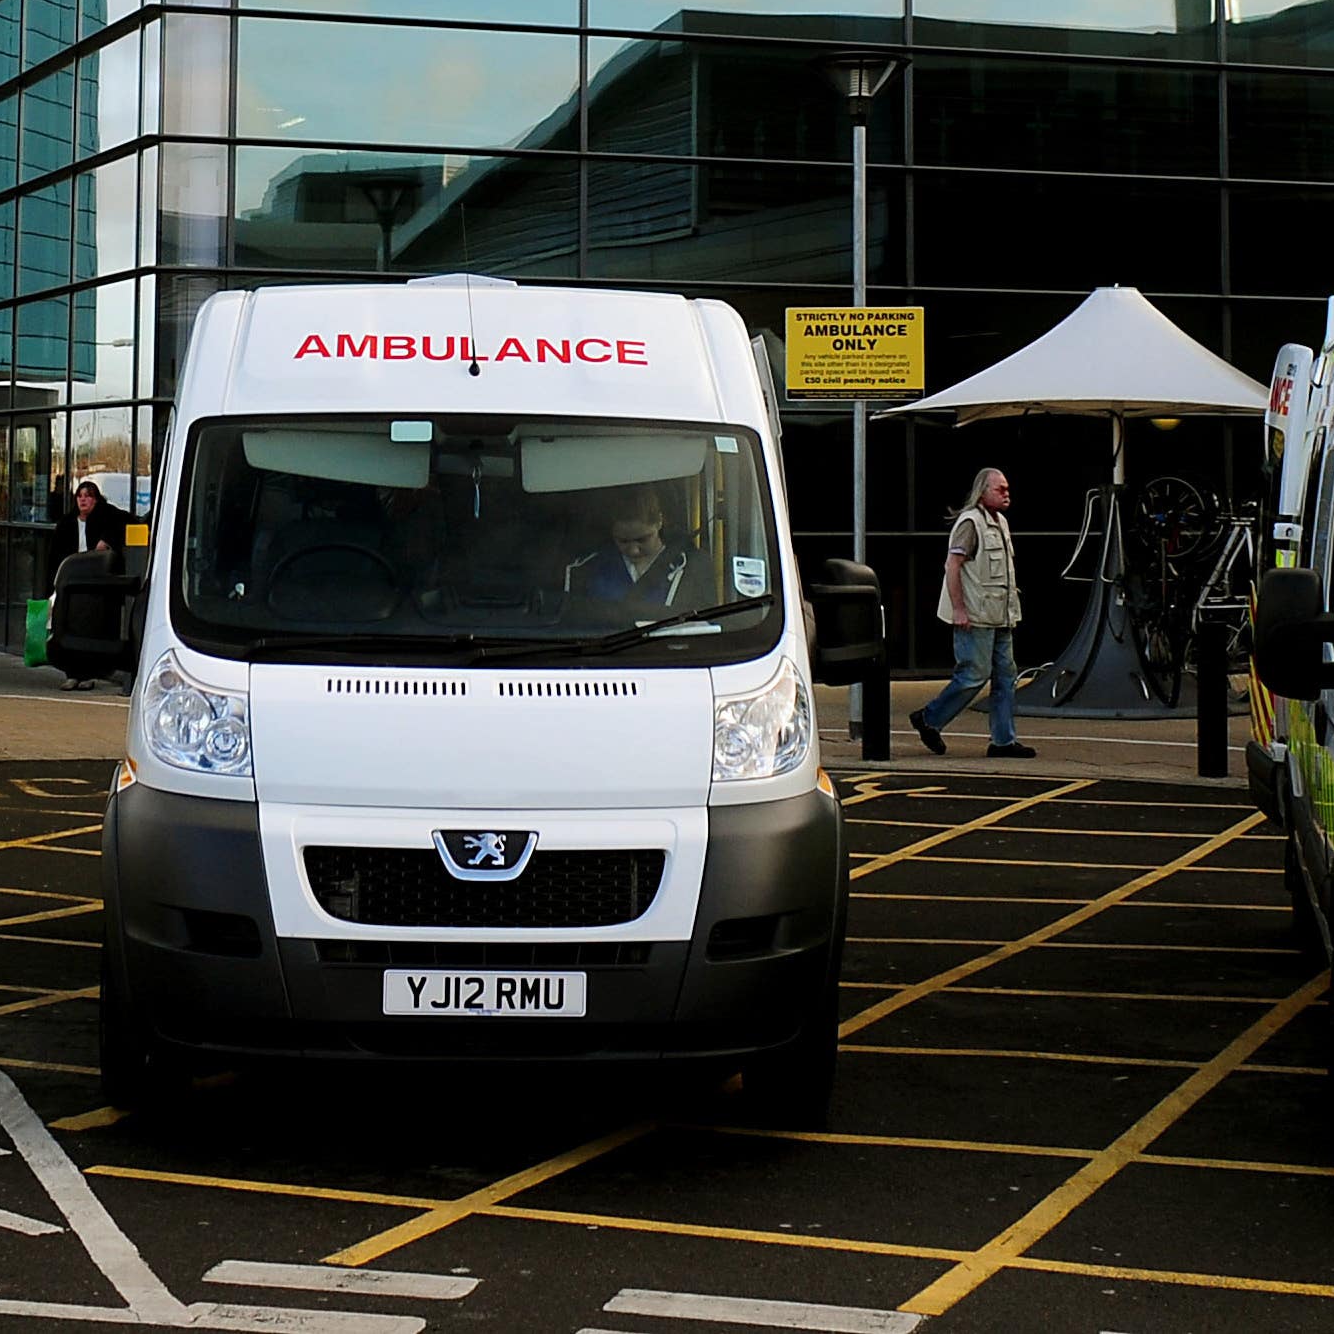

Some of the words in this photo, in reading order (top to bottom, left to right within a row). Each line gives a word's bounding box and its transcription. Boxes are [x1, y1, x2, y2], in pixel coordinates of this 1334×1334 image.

[796, 313, 845, 321] STRICTLY
[804, 324, 907, 336] AMBULANCE
[294, 334, 649, 366] AMBULANCE
[832, 339, 878, 351] ONLY
[844, 377, 876, 385] penalty
[407, 977, 485, 1009] YJ12
[496, 978, 564, 1009] RMU
